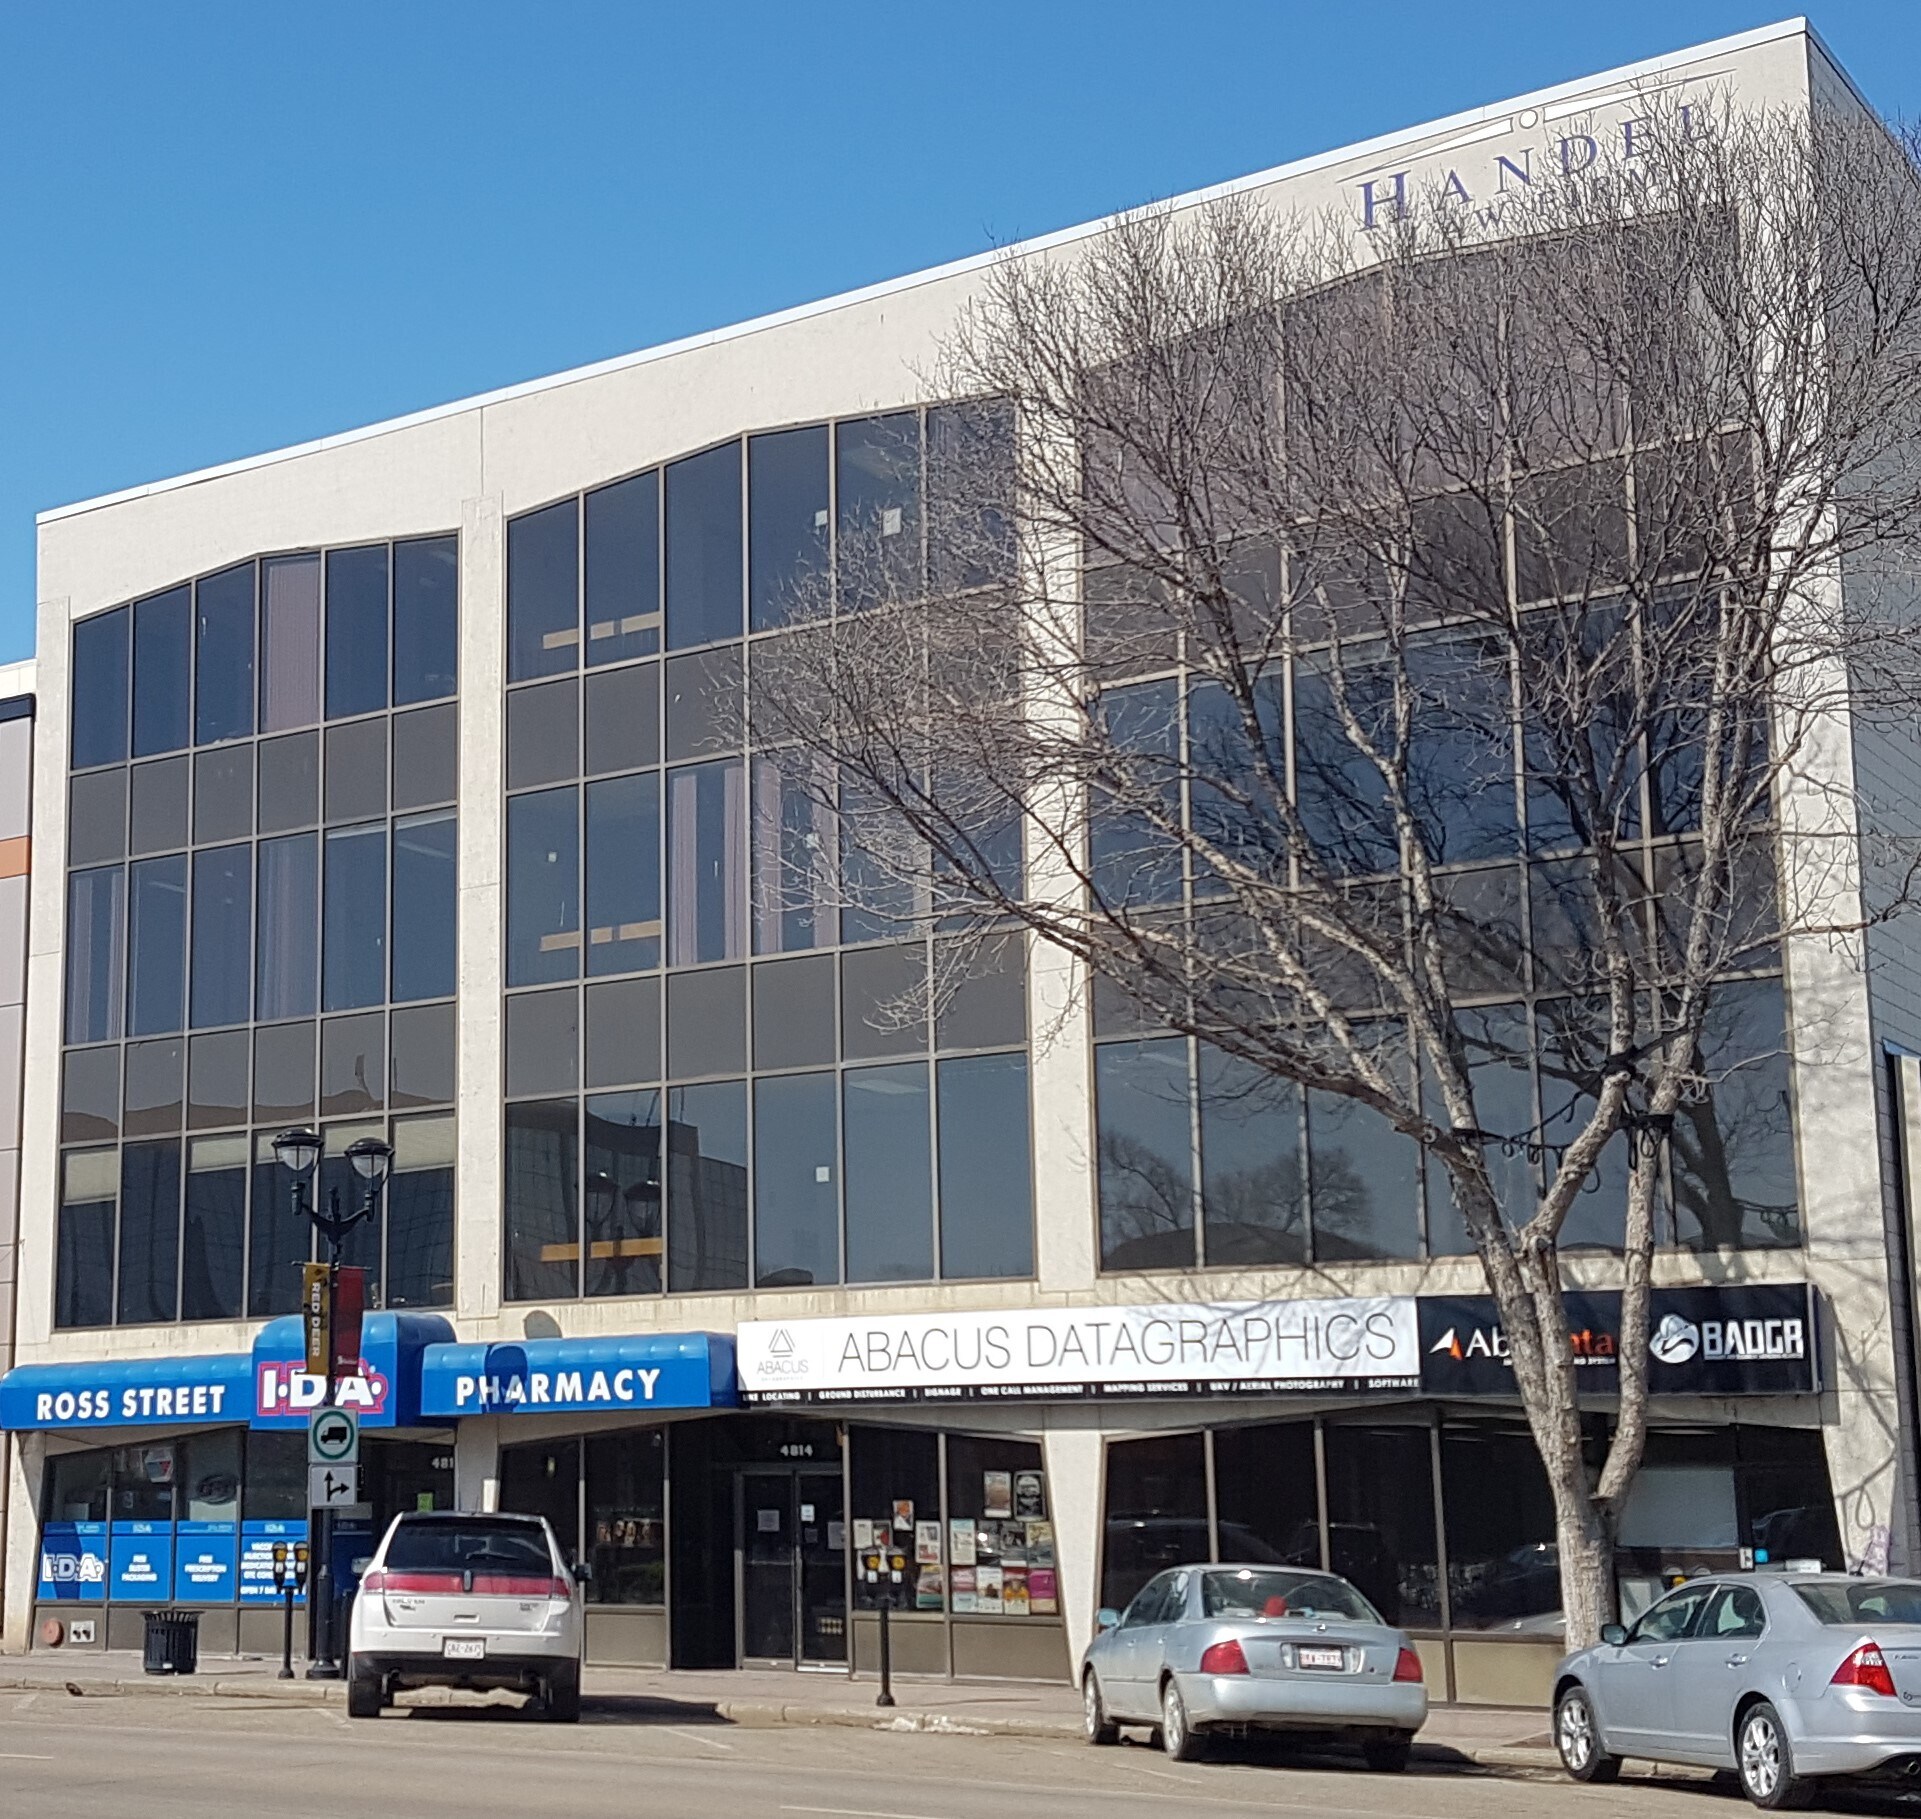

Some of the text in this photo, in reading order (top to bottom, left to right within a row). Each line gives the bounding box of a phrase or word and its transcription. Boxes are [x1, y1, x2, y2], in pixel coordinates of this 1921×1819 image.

[1357, 104, 1714, 233] HANDEL
[311, 1281, 321, 1357] RED DEER
[838, 1313, 1397, 1373] ABACUS DATAGRAPHICS
[1701, 1318, 1804, 1356] BADGR
[757, 1359, 809, 1374] ABACUS
[455, 1369, 660, 1406] PHARMACY
[1103, 1381, 1189, 1393] MAPPING SERVICES
[1239, 1380, 1272, 1391] AERIAL
[1273, 1378, 1345, 1390] PHOTOGRAPHY
[1368, 1377, 1419, 1388] SOFTWARE
[762, 1390, 801, 1402] LOCATING
[818, 1388, 906, 1400] GROUND DISTURBANCE
[924, 1387, 962, 1398] SIGNAGE
[980, 1384, 1084, 1397] ONE CALL MANAGEMENT
[37, 1384, 226, 1420] ROSS STREET
[780, 1444, 813, 1458] 4814
